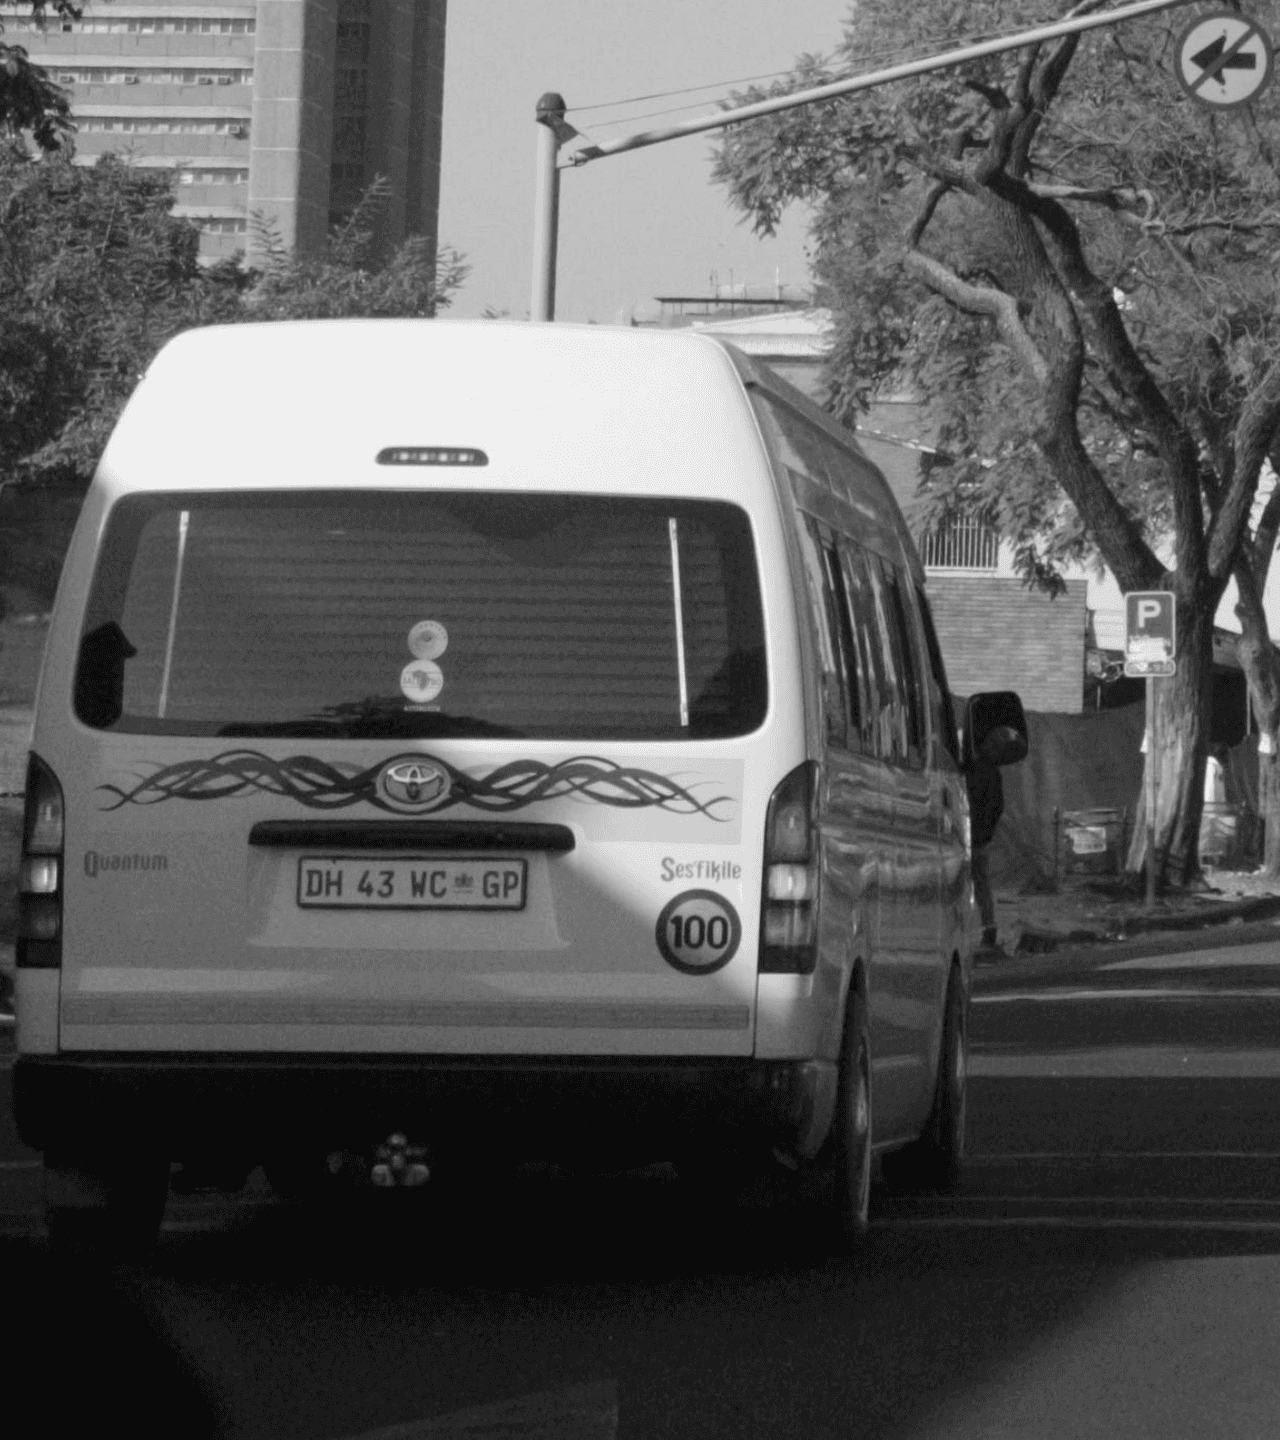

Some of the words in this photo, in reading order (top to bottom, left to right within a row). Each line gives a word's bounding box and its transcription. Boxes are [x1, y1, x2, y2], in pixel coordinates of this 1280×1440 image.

[1138, 600, 1161, 628] P
[84, 850, 168, 878] Quantum
[306, 869, 343, 897] DH
[357, 870, 395, 898] 43
[411, 870, 447, 898] WC
[482, 870, 519, 898] GP
[670, 914, 728, 950] 100
